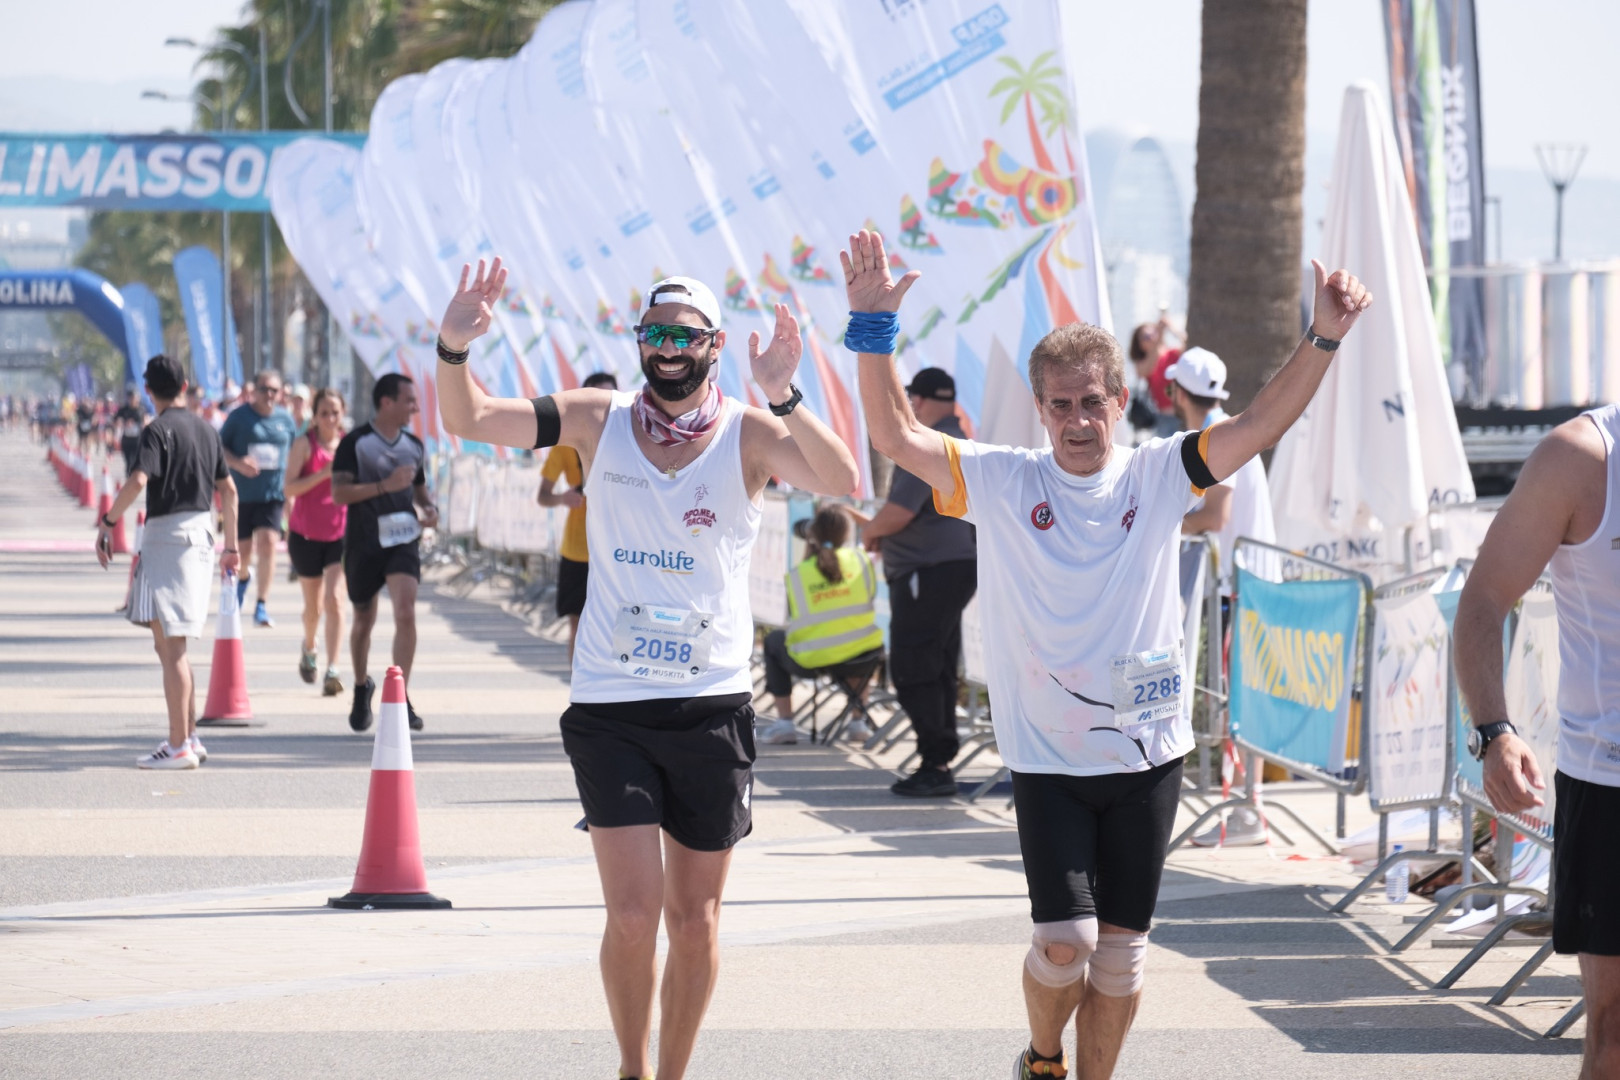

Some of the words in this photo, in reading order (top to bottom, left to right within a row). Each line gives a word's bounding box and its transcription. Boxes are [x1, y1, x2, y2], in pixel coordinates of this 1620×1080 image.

[0, 143, 276, 198] LIMASSO
[603, 471, 649, 489] macron
[686, 516, 712, 528] RACING
[613, 548, 694, 571] eurolife
[632, 636, 692, 664] 2058
[652, 668, 685, 679] MUSKITA
[1134, 674, 1181, 705] 2288
